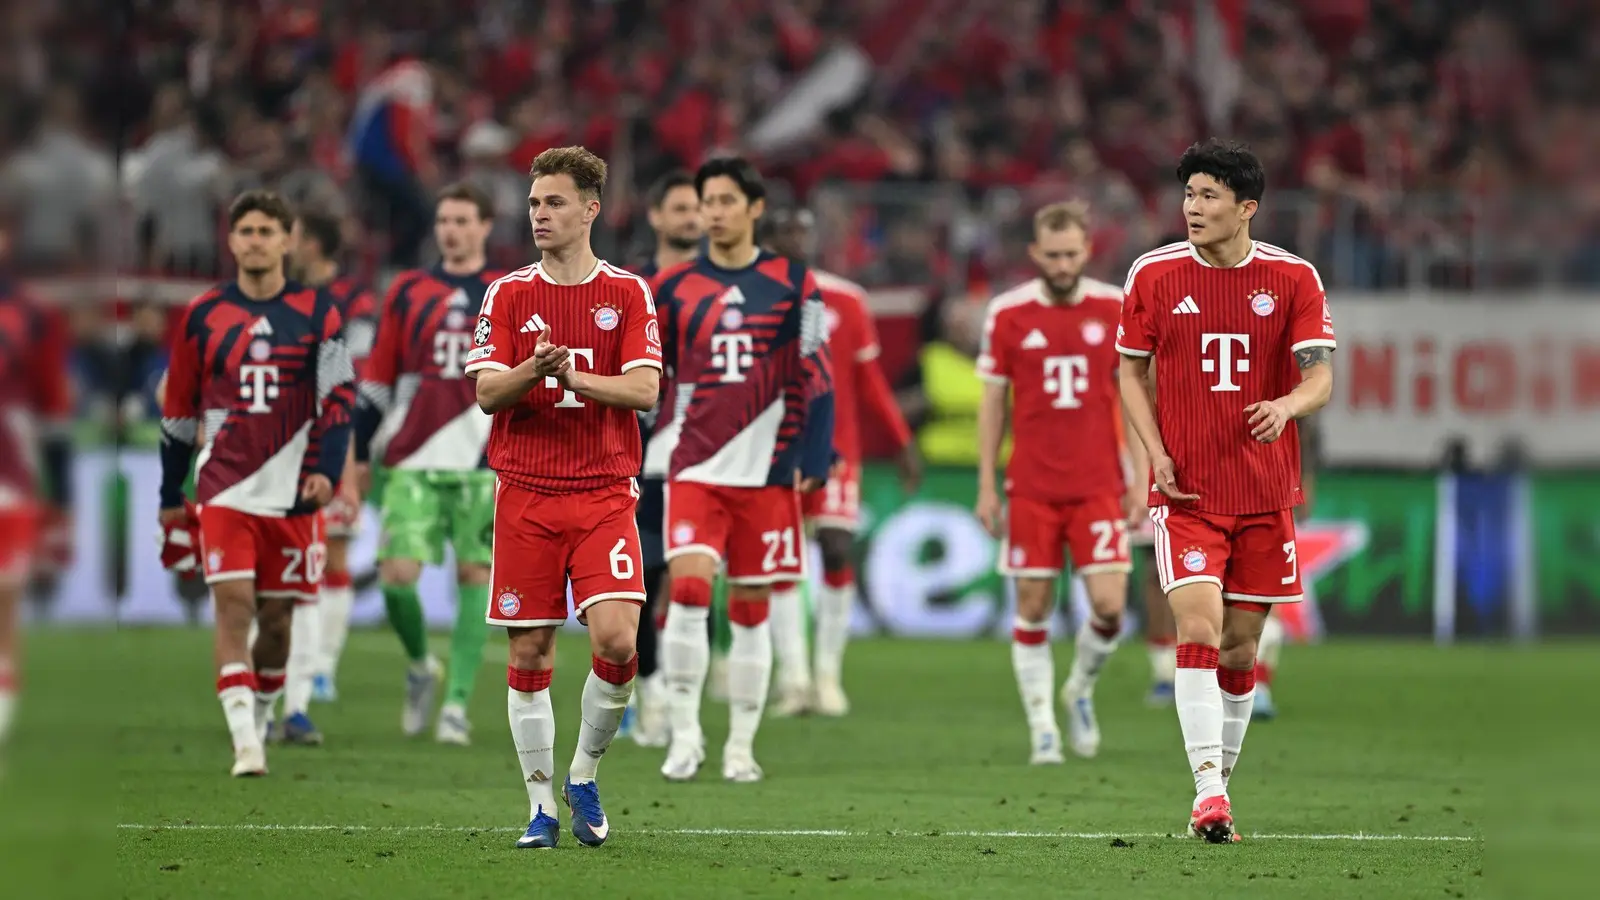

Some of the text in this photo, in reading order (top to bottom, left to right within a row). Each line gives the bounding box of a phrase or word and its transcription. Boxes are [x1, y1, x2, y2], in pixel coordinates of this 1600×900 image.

[434, 331, 472, 379] T
[711, 334, 753, 382] T
[1201, 333, 1250, 391] T
[240, 364, 279, 413] T
[1043, 355, 1089, 409] T
[609, 538, 634, 580] 6
[761, 526, 799, 573] 21
[1281, 540, 1297, 585] 3
